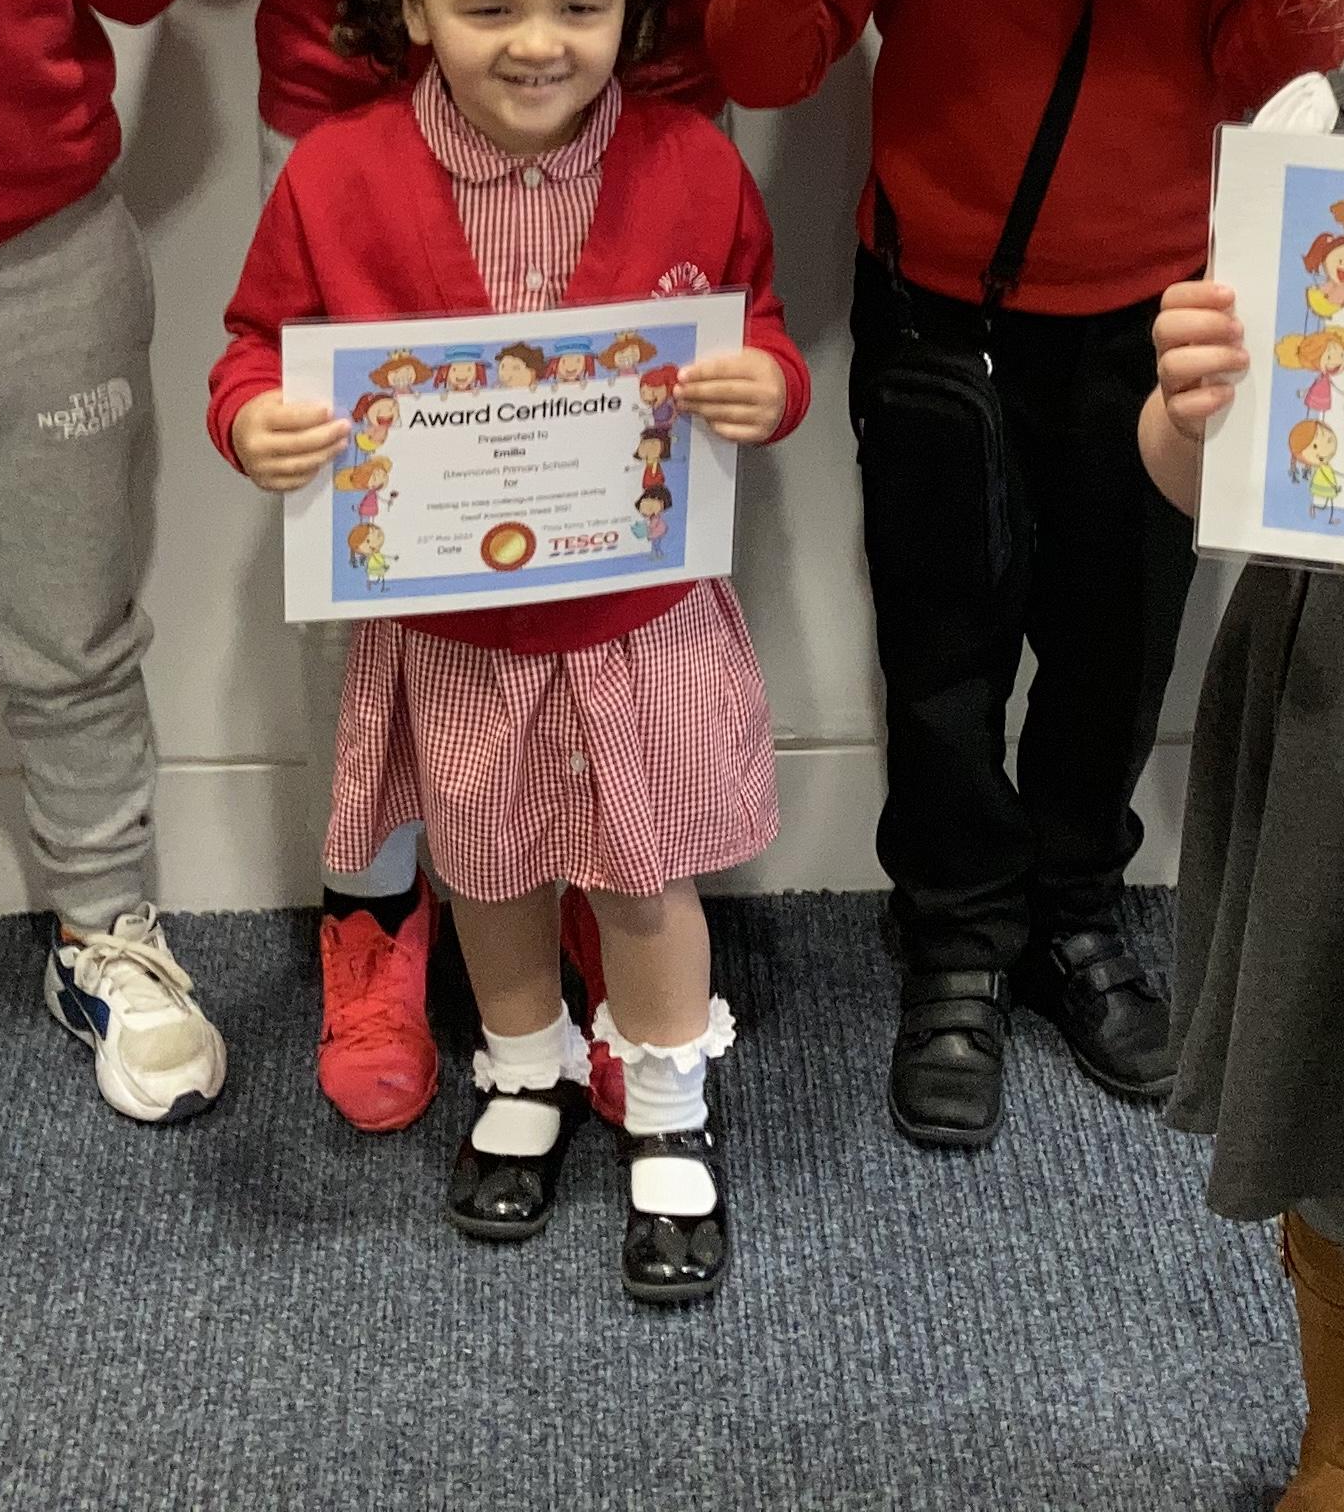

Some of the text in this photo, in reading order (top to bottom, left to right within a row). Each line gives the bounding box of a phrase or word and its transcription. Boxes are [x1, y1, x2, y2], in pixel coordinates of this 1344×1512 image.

[69, 383, 106, 409] THE
[409, 392, 622, 429] Award Certificate
[478, 429, 549, 445] Presented to
[503, 478, 518, 488] for
[548, 530, 619, 551] TESCO
[437, 544, 462, 556] Date
